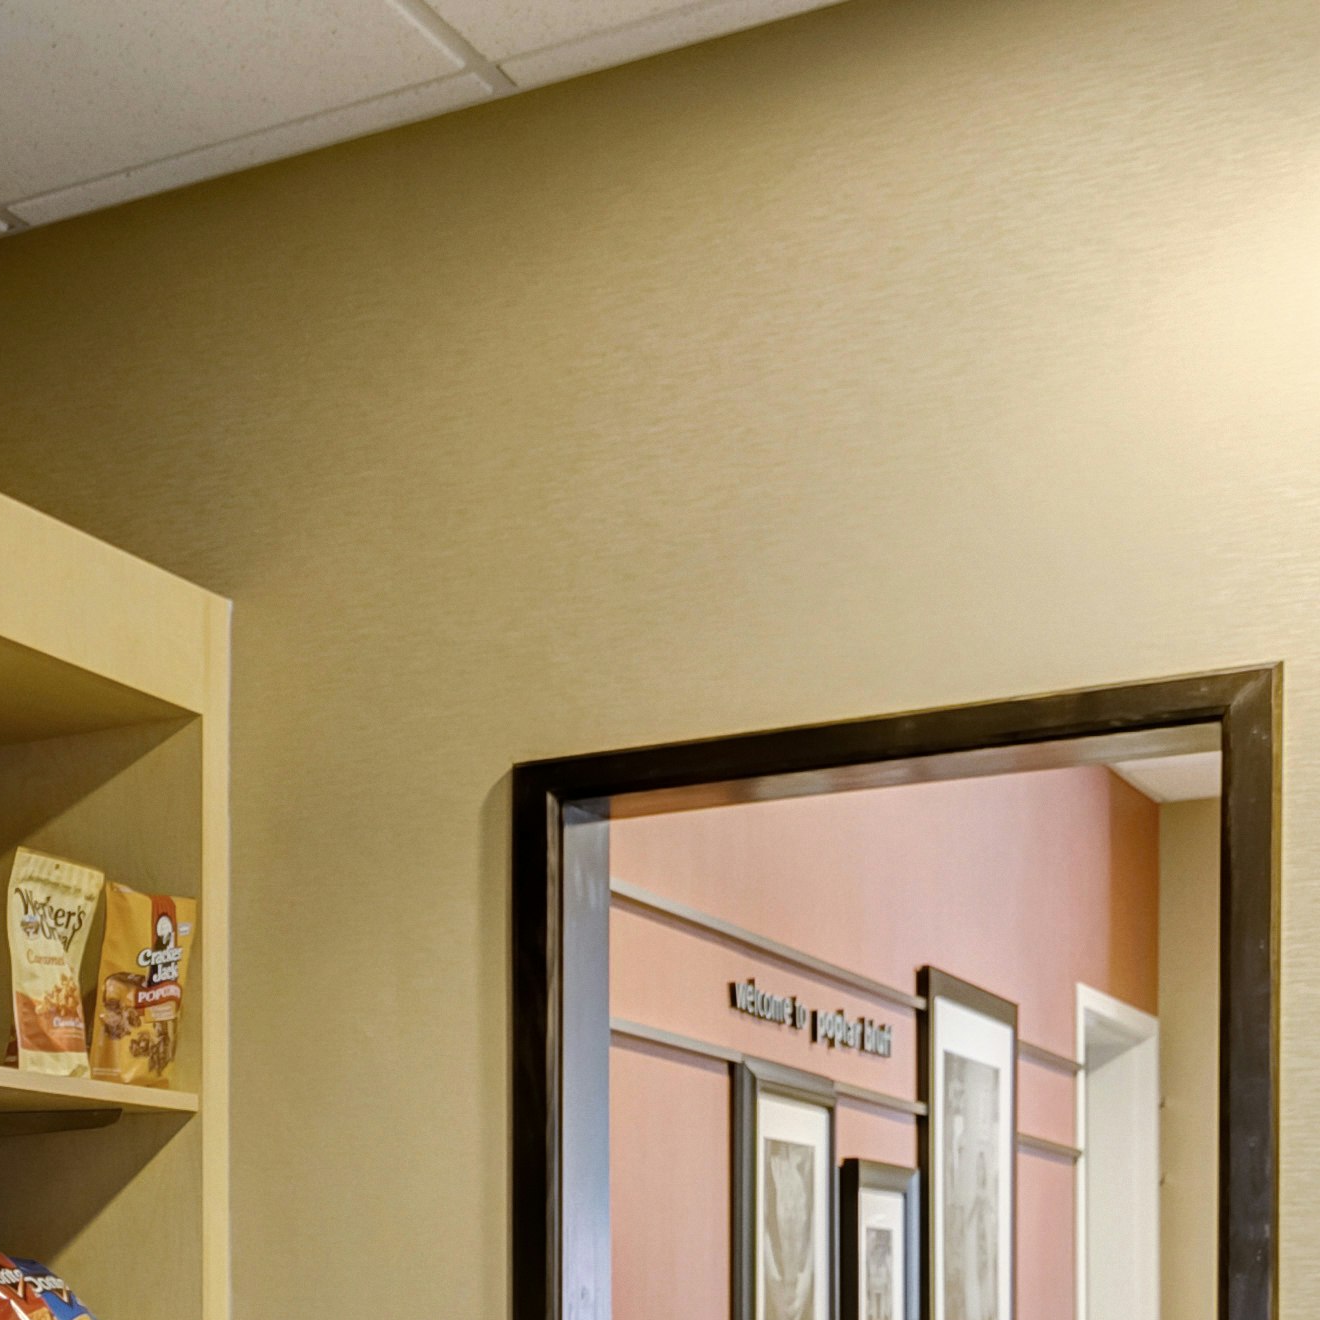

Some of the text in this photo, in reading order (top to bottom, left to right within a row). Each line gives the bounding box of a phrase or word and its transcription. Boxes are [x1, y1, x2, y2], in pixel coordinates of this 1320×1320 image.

[136, 948, 183, 967] Cracker
[152, 961, 179, 983] Jack
[732, 980, 793, 1027] welcome
[793, 1000, 806, 1030] to
[815, 1010, 863, 1050] poplar
